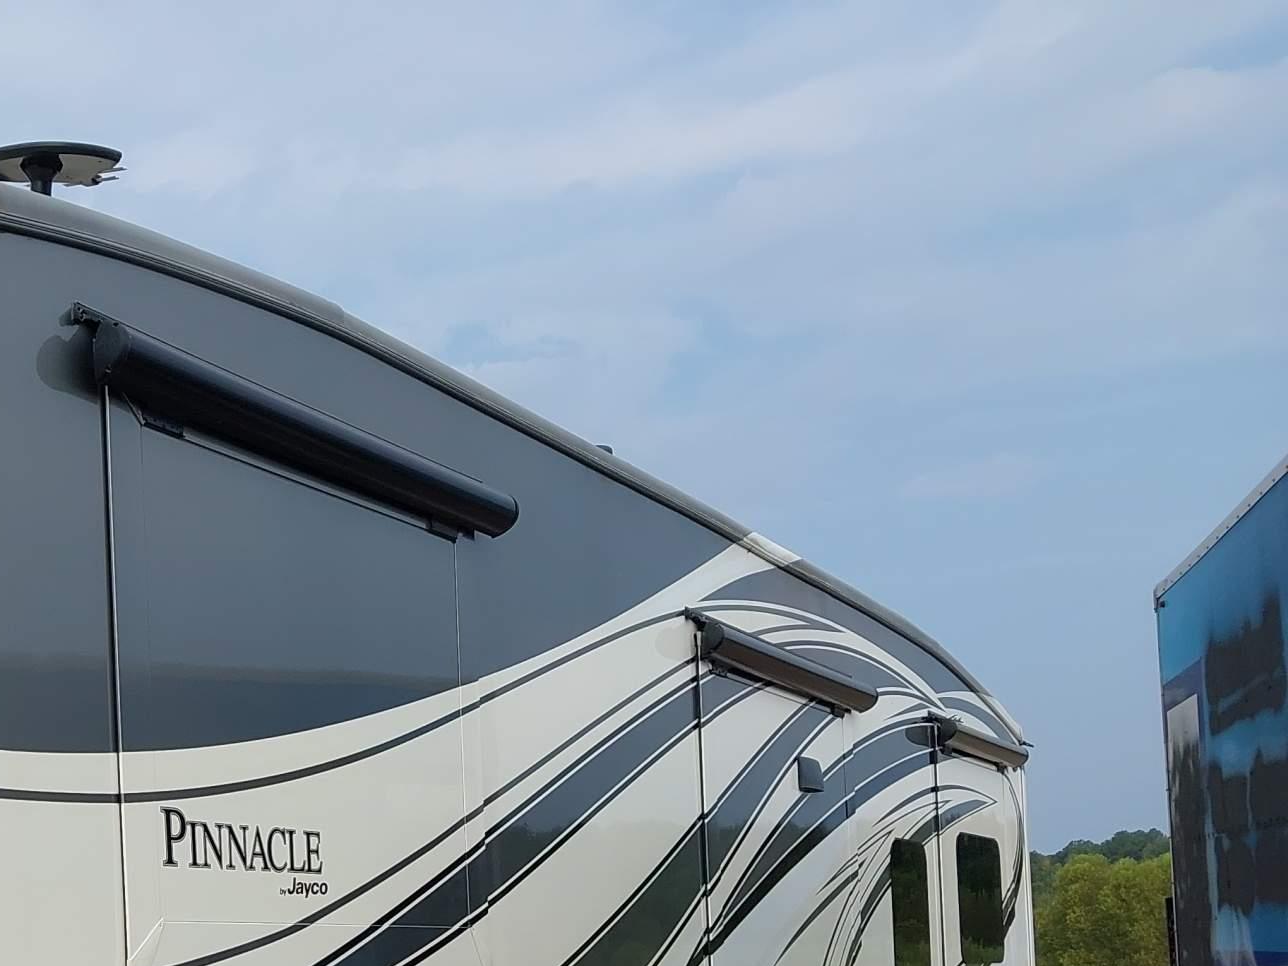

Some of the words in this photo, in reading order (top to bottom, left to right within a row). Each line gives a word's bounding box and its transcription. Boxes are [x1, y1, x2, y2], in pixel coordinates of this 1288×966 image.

[160, 806, 324, 874] PINNACLE
[279, 887, 287, 896] by
[287, 877, 329, 898] Jayco
